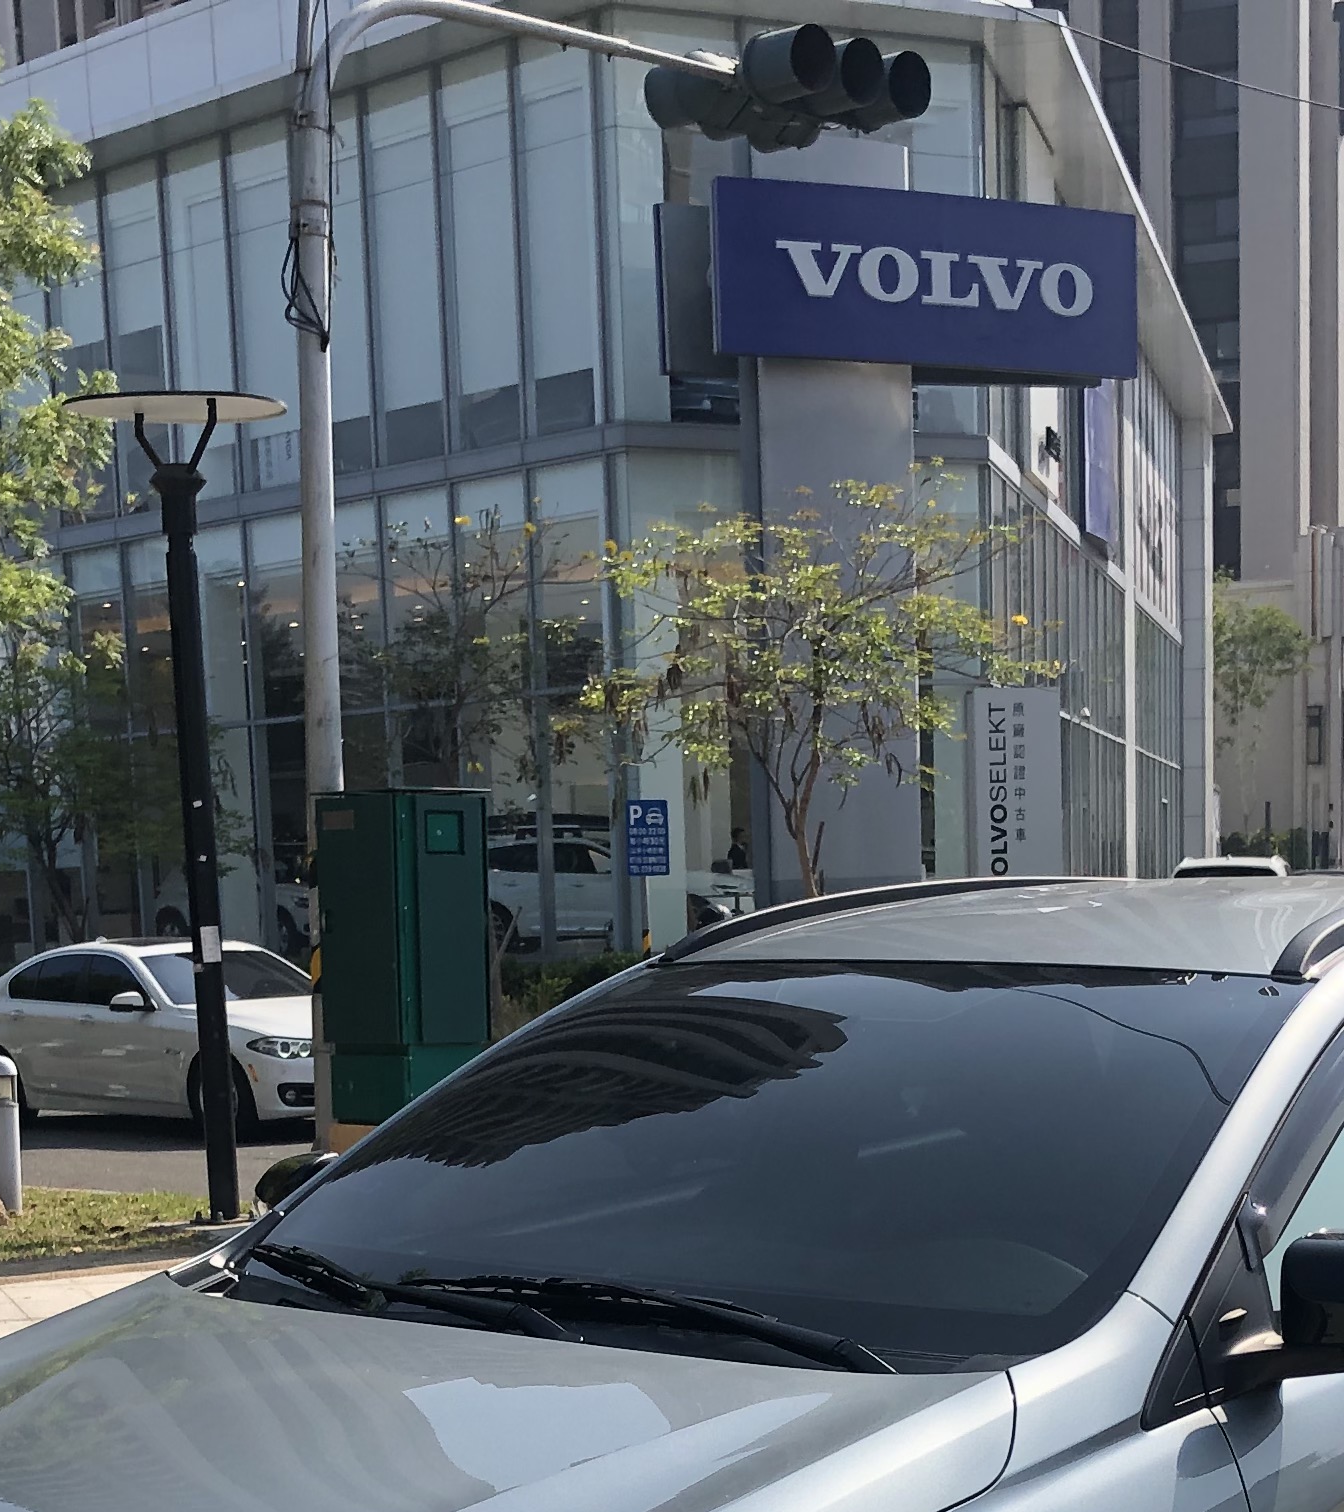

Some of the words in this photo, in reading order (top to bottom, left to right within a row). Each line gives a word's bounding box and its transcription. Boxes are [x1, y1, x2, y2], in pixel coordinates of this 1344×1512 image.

[776, 239, 1094, 318] VOLVO
[629, 805, 643, 825] P
[988, 702, 1009, 876] OLVOSELEKT
[1012, 702, 1027, 842] 原廠認證中古車
